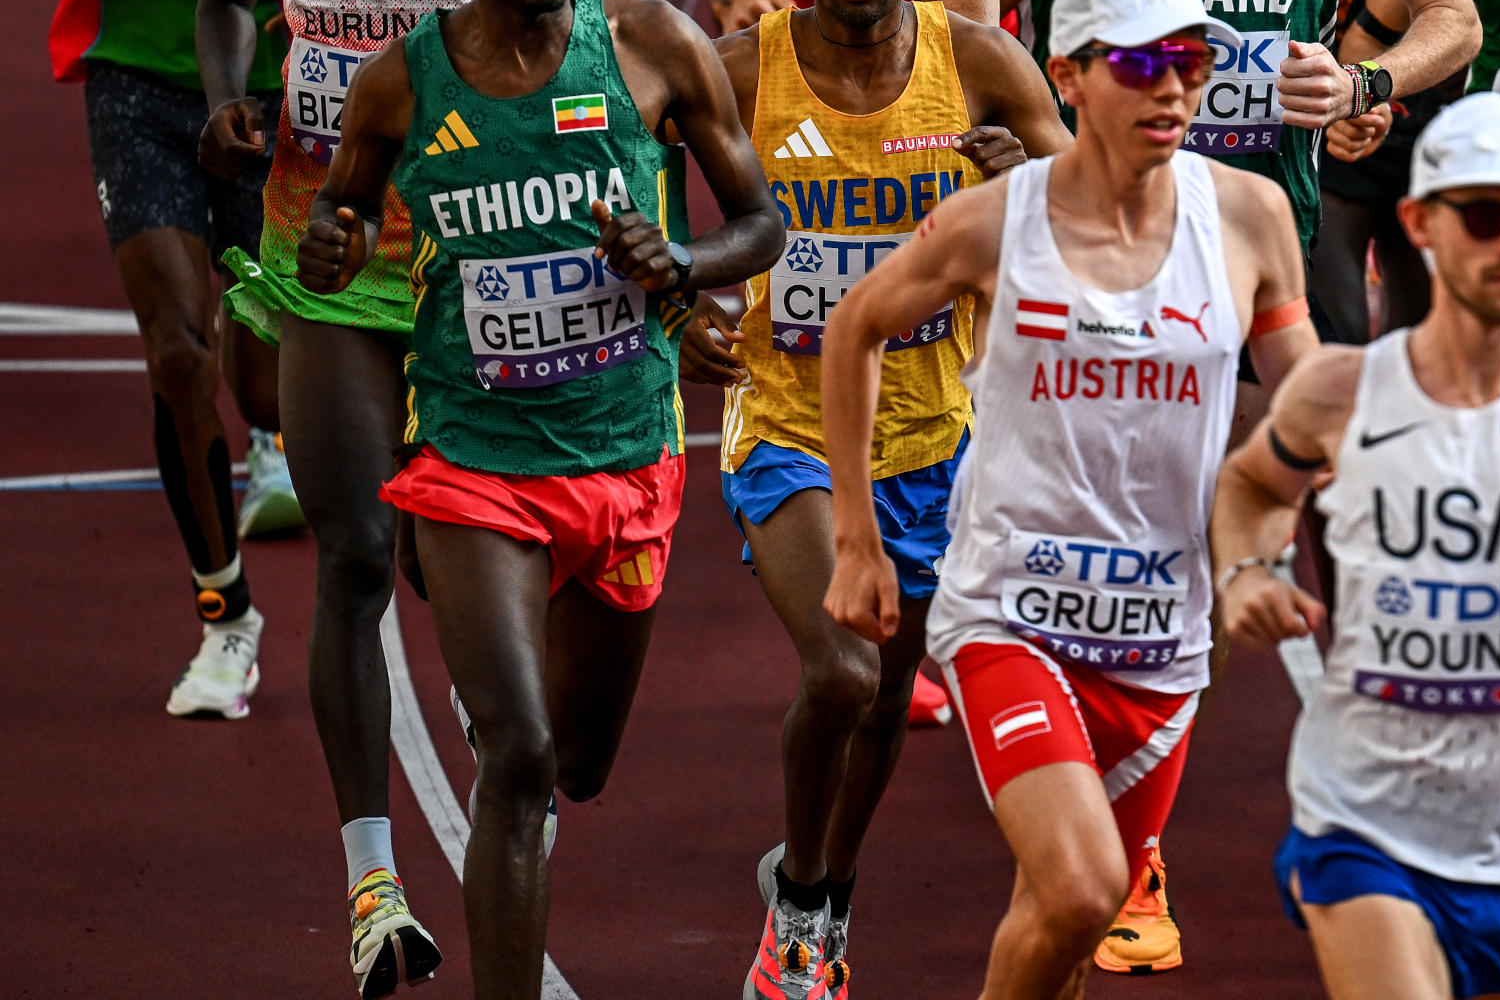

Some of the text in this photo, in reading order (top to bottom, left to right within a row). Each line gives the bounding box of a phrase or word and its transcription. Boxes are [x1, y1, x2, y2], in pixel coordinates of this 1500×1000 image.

[304, 9, 420, 41] BURUN
[1207, 39, 1275, 74] DK
[298, 91, 346, 132] BIZ
[1200, 82, 1273, 122] CH
[430, 167, 632, 239] ETHIOPIA
[772, 170, 963, 230] SWEDEN
[825, 241, 905, 276] TD
[480, 293, 635, 352] GELETA
[785, 285, 850, 323] CH
[1077, 318, 1136, 338] helvetia
[1031, 359, 1200, 406] AUSTRIA
[1067, 543, 1183, 587] TDK
[1016, 586, 1175, 635] GRUEN
